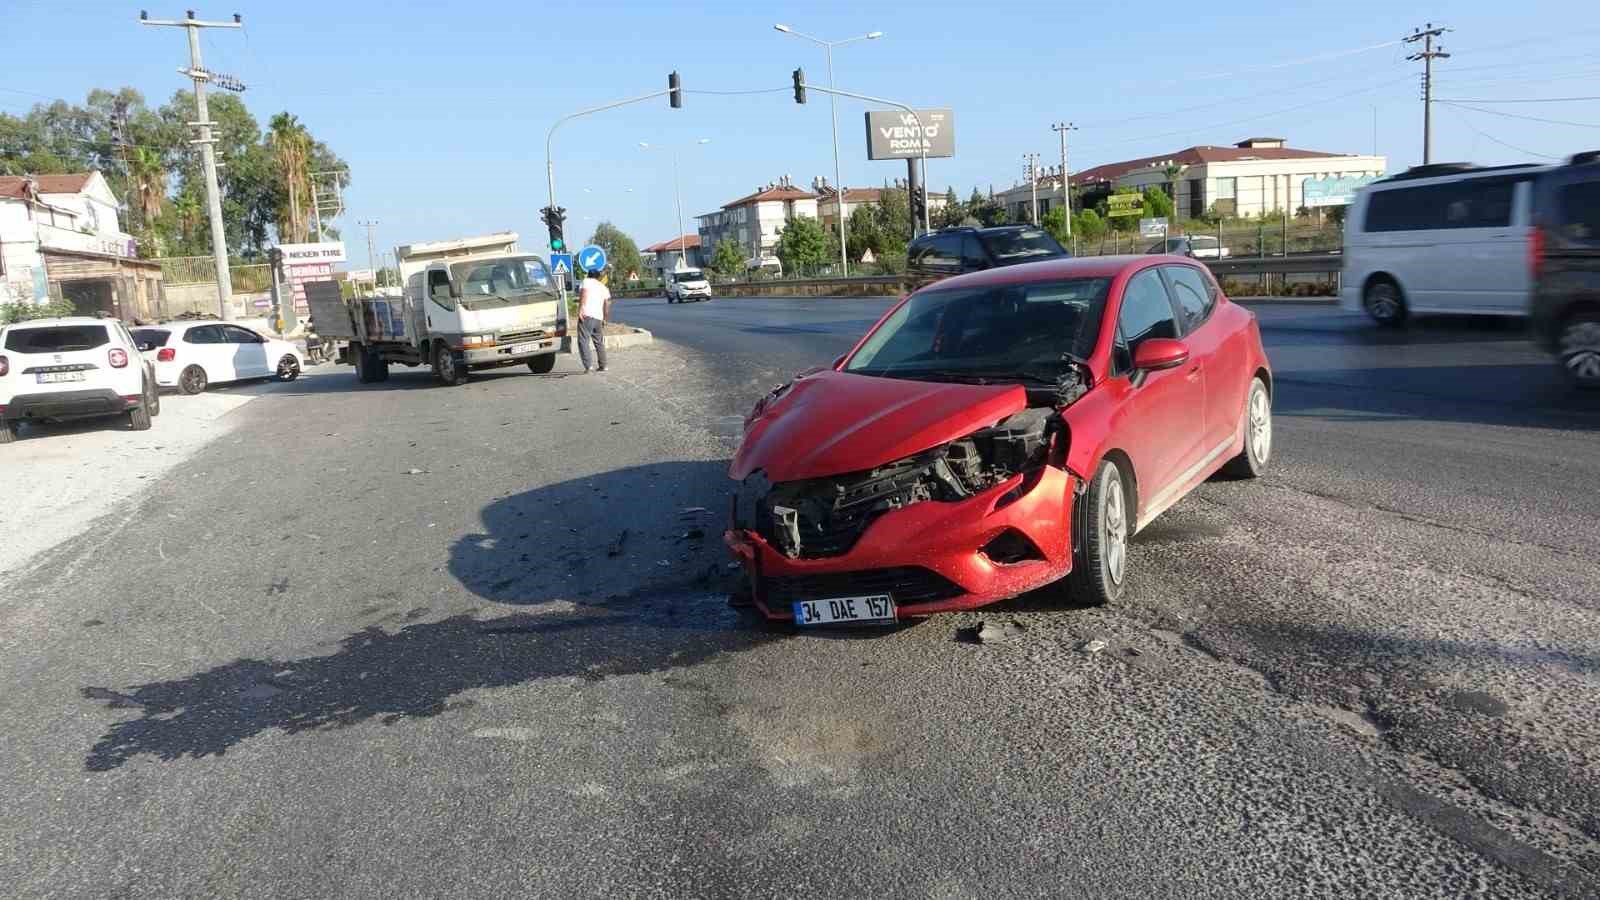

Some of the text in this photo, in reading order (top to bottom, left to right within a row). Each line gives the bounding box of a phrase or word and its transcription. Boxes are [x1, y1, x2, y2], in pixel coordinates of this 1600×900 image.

[880, 126, 938, 138] VENTO
[890, 139, 931, 148] ROMA
[802, 602, 820, 622] 34
[829, 599, 858, 620] DAE
[865, 597, 888, 617] 157
